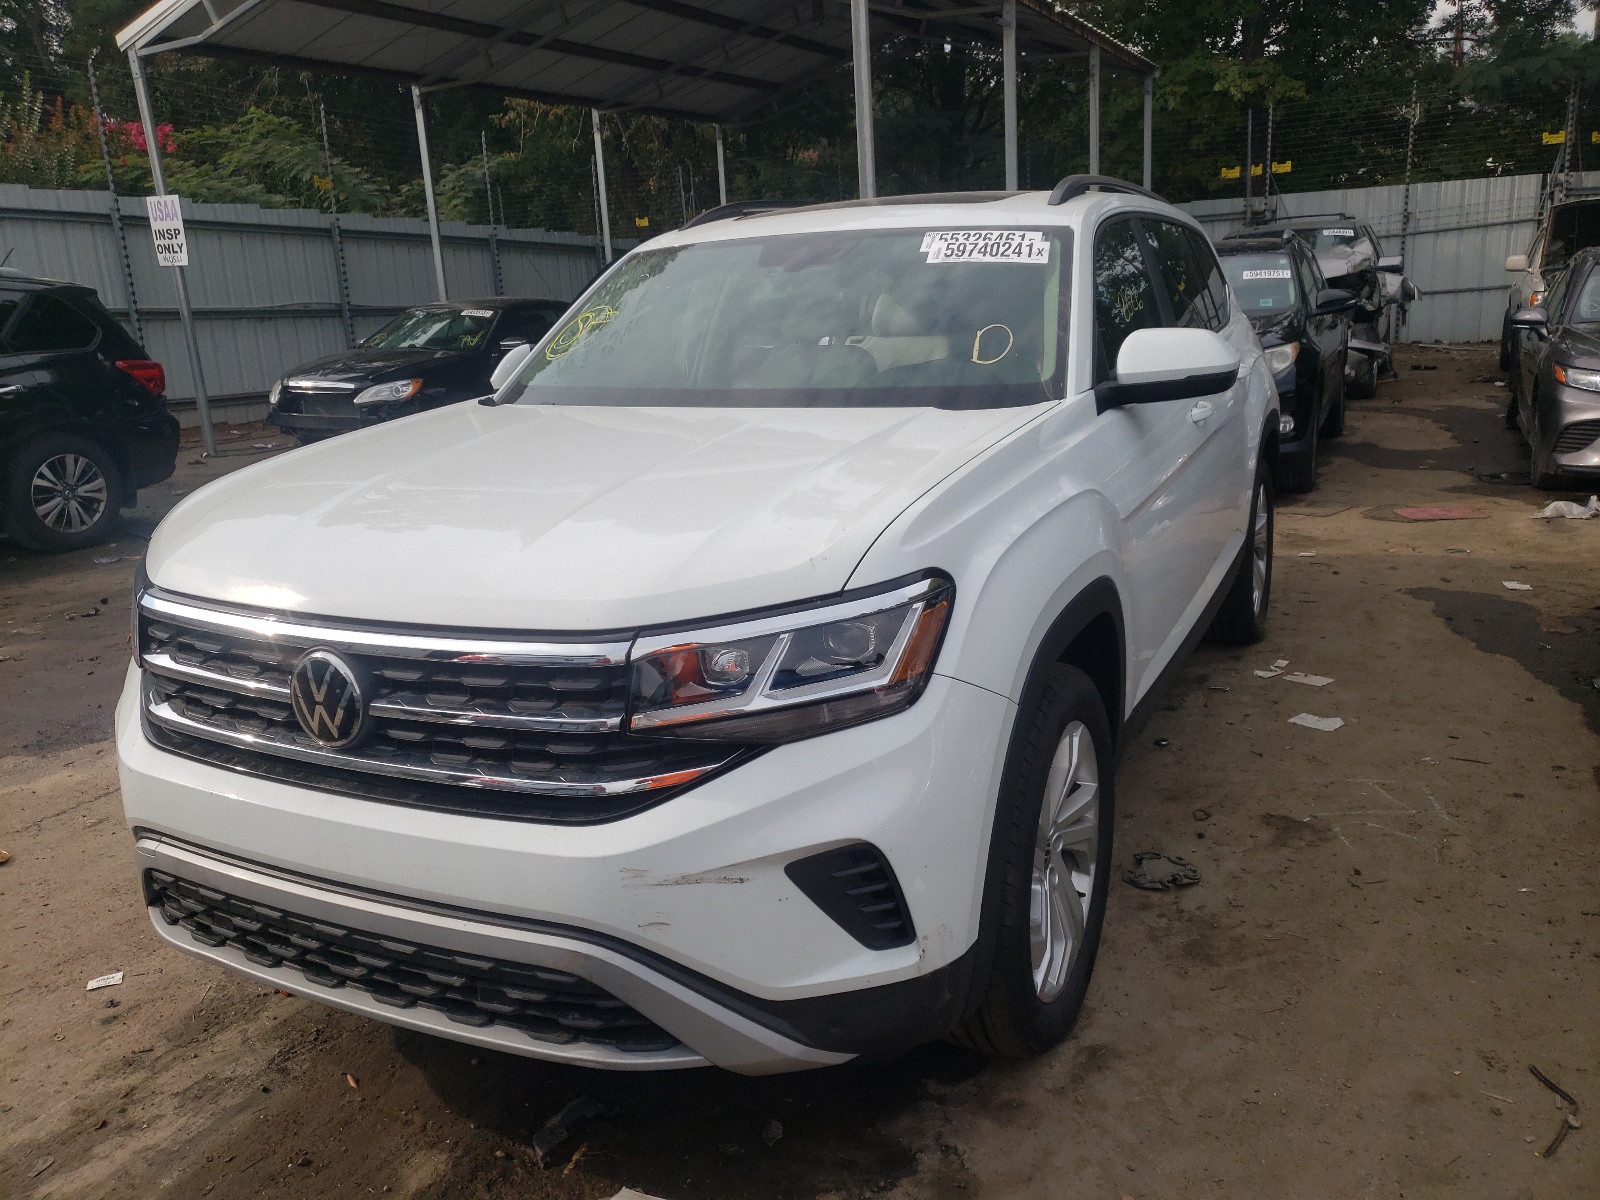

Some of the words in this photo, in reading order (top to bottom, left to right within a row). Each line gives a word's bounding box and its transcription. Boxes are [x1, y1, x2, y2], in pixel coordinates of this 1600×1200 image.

[150, 200, 179, 222] USAA
[154, 228, 181, 241] INSP
[157, 243, 184, 255] ONLY
